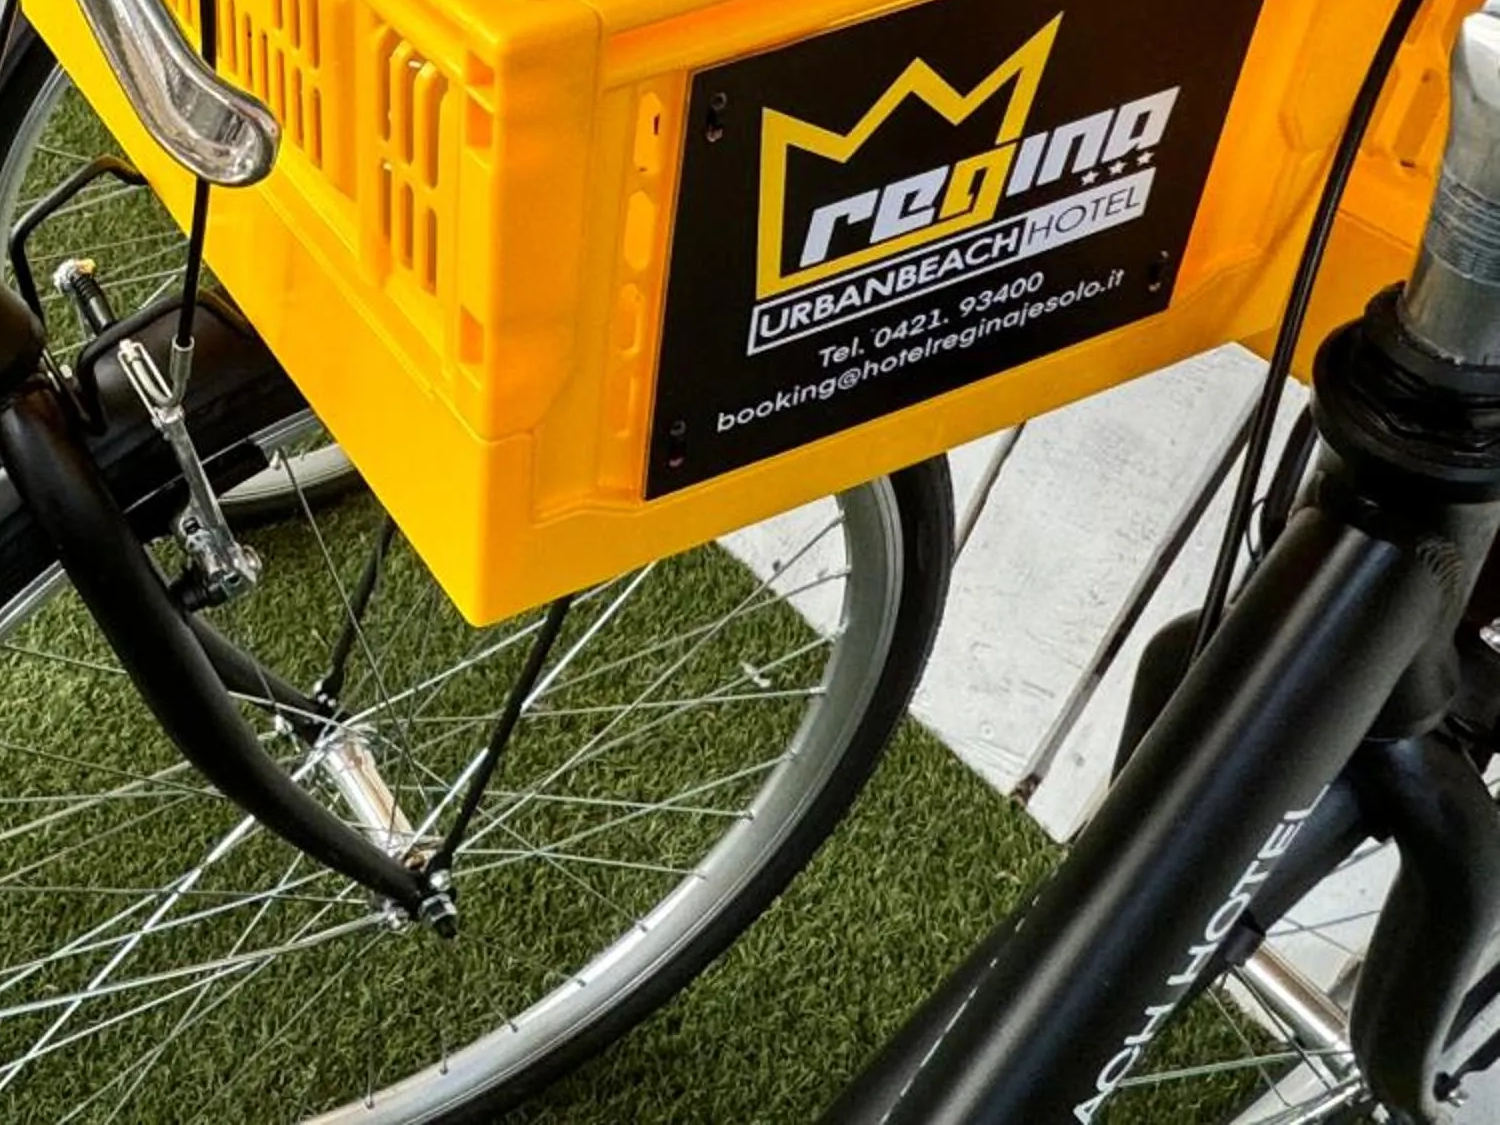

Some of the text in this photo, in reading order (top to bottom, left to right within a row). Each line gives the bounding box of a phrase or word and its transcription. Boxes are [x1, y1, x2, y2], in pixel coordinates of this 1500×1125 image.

[716, 269, 1125, 432] booking@hotelreginajesolo.it
[819, 271, 1045, 368] Tel. 0421. 93400
[1167, 783, 1331, 986] HOTEL
